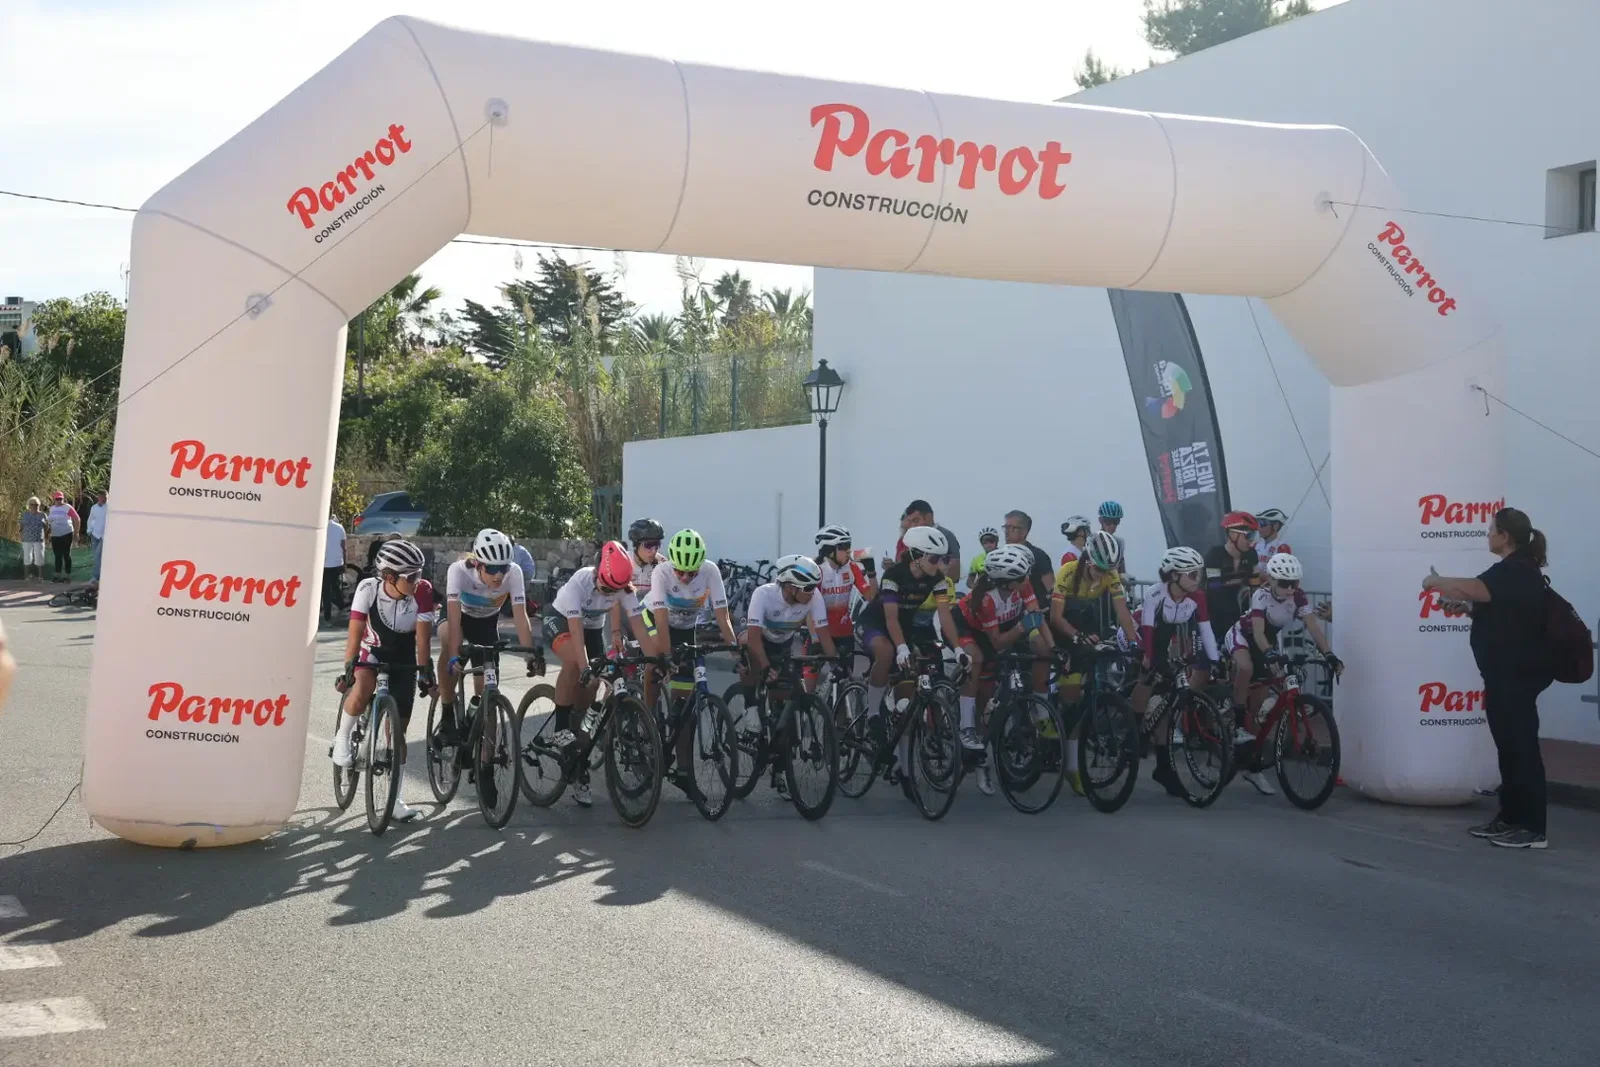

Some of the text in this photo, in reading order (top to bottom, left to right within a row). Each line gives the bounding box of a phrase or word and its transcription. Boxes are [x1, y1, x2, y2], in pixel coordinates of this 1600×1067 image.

[810, 103, 1073, 200] Parrot
[286, 124, 412, 229] Parrot
[314, 184, 386, 243] CONSTRUCCIÓN
[807, 189, 968, 224] CONSTRUCCIÓN
[1367, 242, 1415, 297] CONSTRUCCIÓN
[1377, 221, 1456, 316] Parrot
[170, 439, 312, 489] Parrot
[169, 487, 262, 502] CONSTRUCCIÓN
[158, 559, 302, 608] Parrot
[157, 607, 251, 622] CONSTRUCCIÓN
[1418, 624, 1471, 633] CONSTRUC
[147, 681, 290, 727] Parrot
[1419, 682, 1487, 712] Parr
[145, 729, 240, 744] CONSTRUCCIÓN
